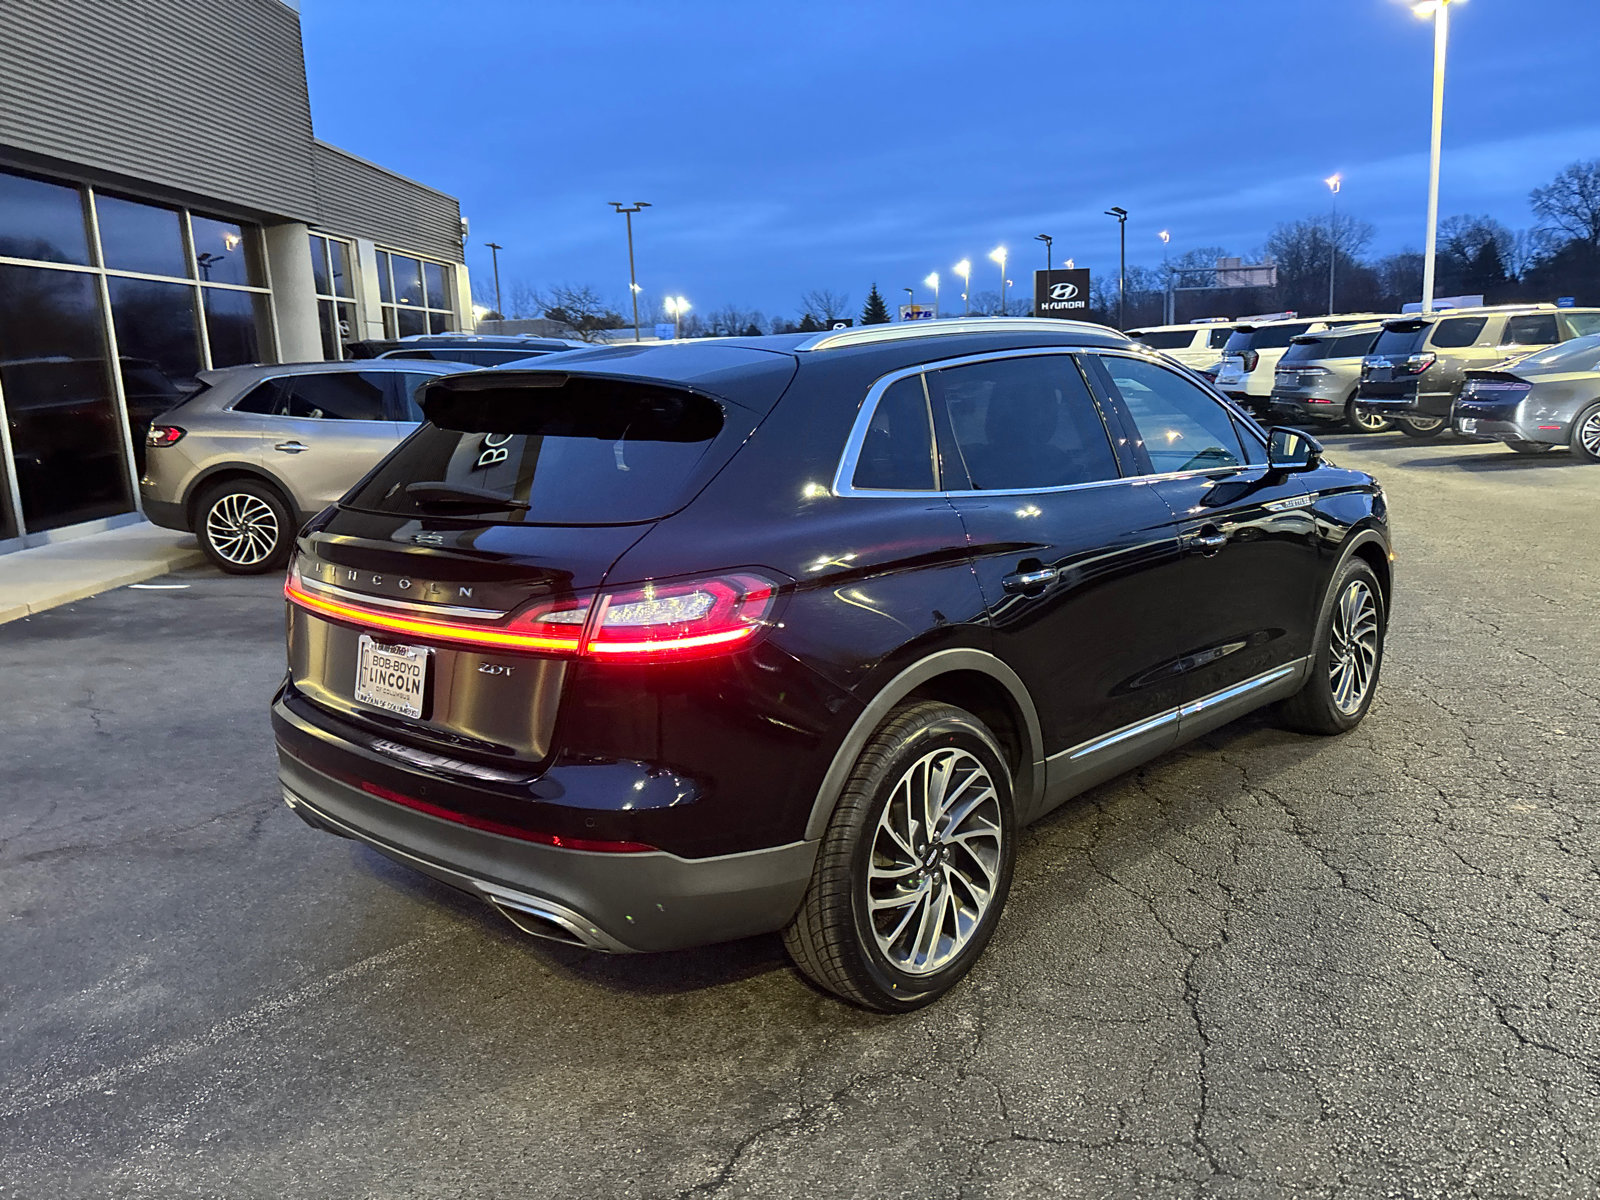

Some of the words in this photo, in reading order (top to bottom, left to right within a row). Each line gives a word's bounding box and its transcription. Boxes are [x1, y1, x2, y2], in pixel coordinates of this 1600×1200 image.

[1041, 301, 1085, 310] HYUNDAI
[315, 563, 473, 598] LINCOLN
[369, 667, 421, 695] LINCOLN
